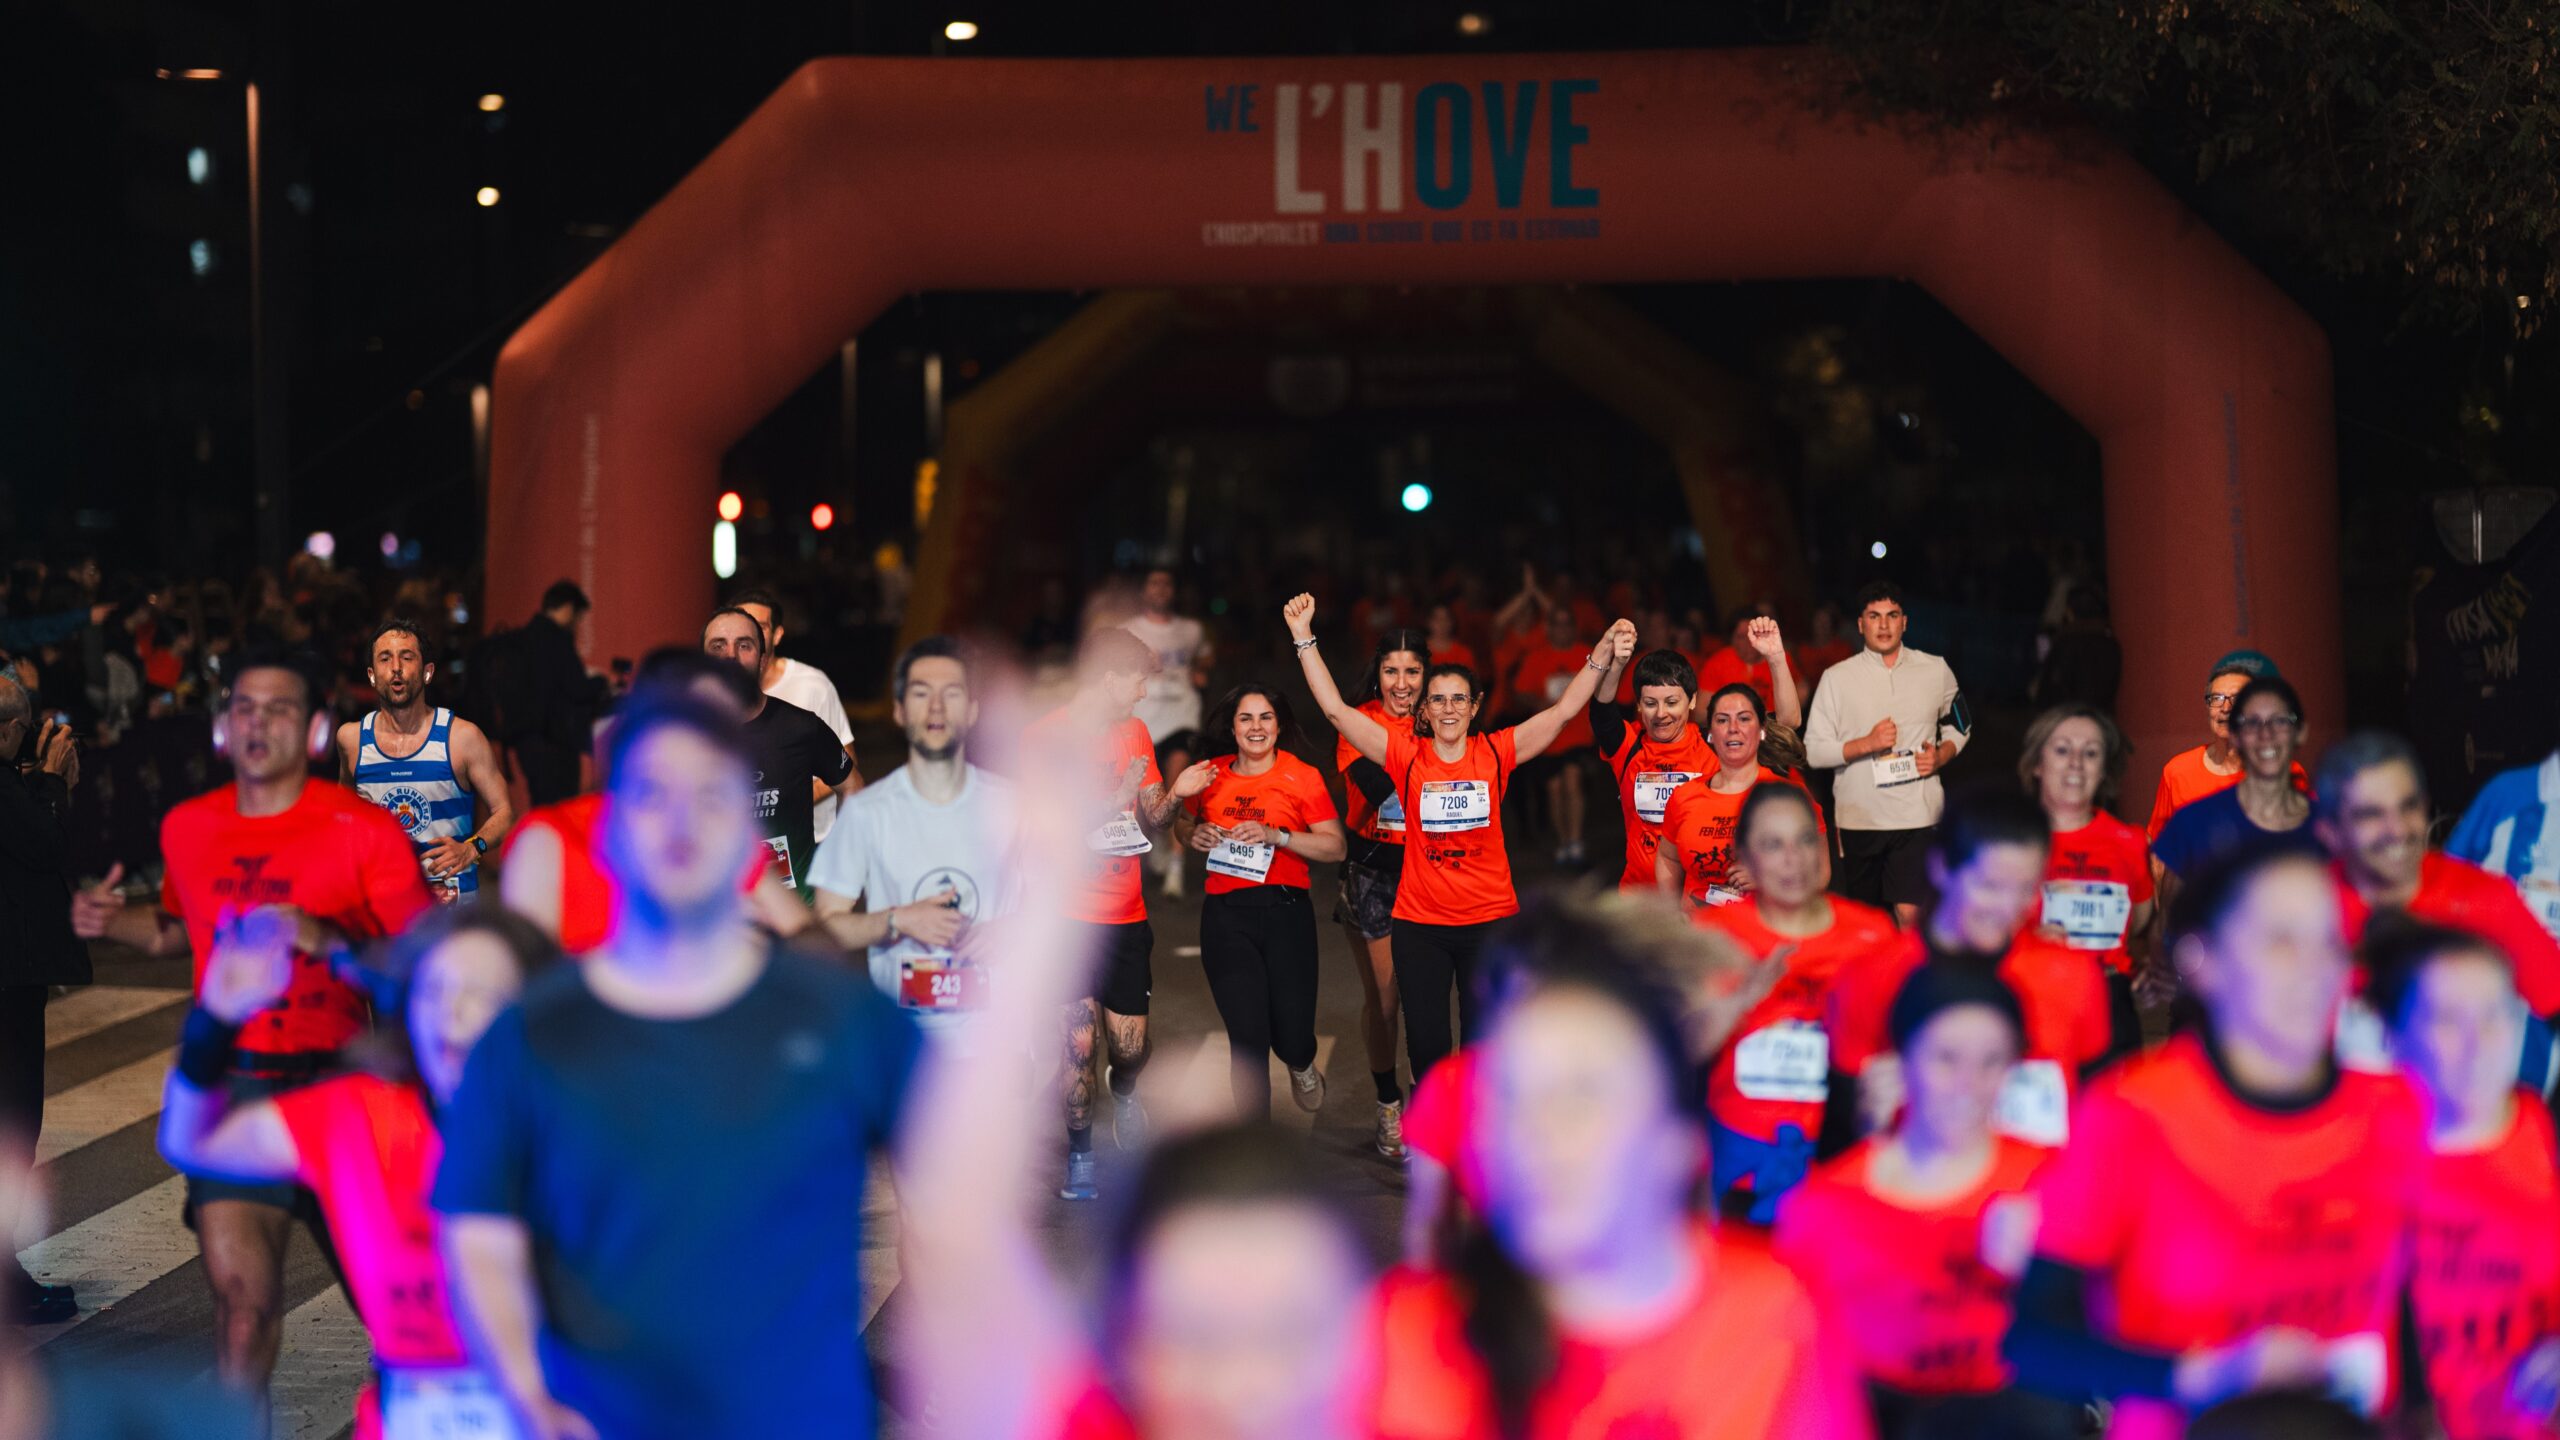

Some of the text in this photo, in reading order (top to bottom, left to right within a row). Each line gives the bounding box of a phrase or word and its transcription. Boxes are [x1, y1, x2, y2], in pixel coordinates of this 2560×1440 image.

[1204, 84, 1261, 132] WE
[396, 788, 430, 820] RUNNERS
[1440, 796, 1468, 809] 7208
[1229, 842, 1255, 859] 6495
[930, 974, 961, 997] 243
